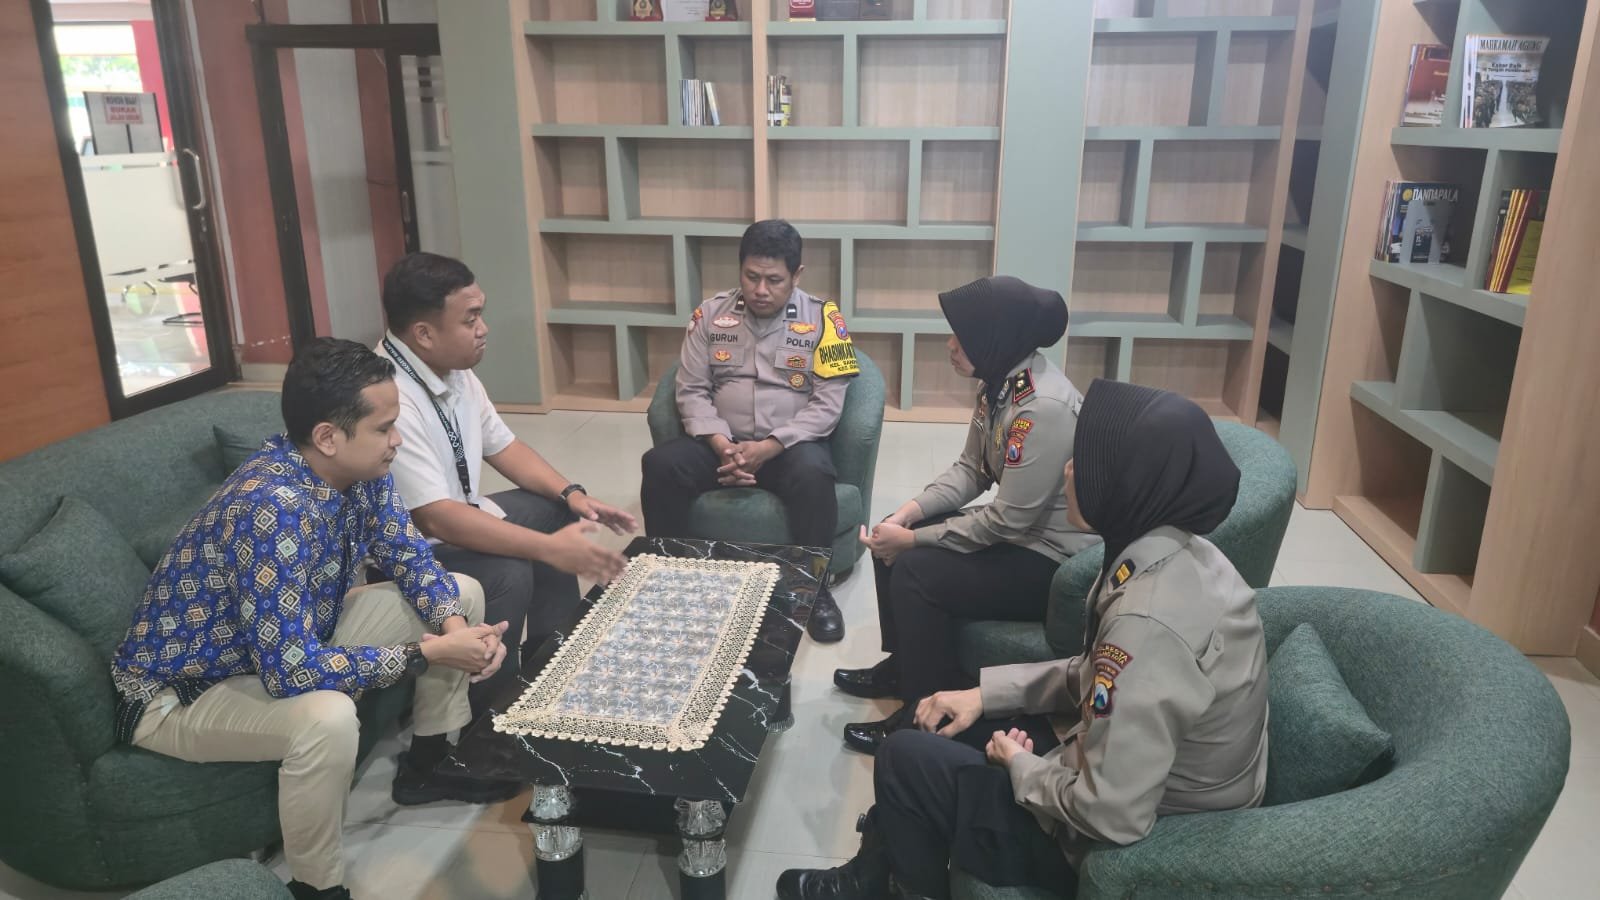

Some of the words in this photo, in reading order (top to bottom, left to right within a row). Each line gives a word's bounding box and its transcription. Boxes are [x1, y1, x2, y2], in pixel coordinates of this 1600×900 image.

[1480, 39, 1517, 51] MAHKAMAH
[1518, 39, 1543, 51] AGUNG
[1412, 188, 1458, 202] DANDAPALA
[709, 333, 738, 343] GURUH
[786, 337, 814, 349] POLRI
